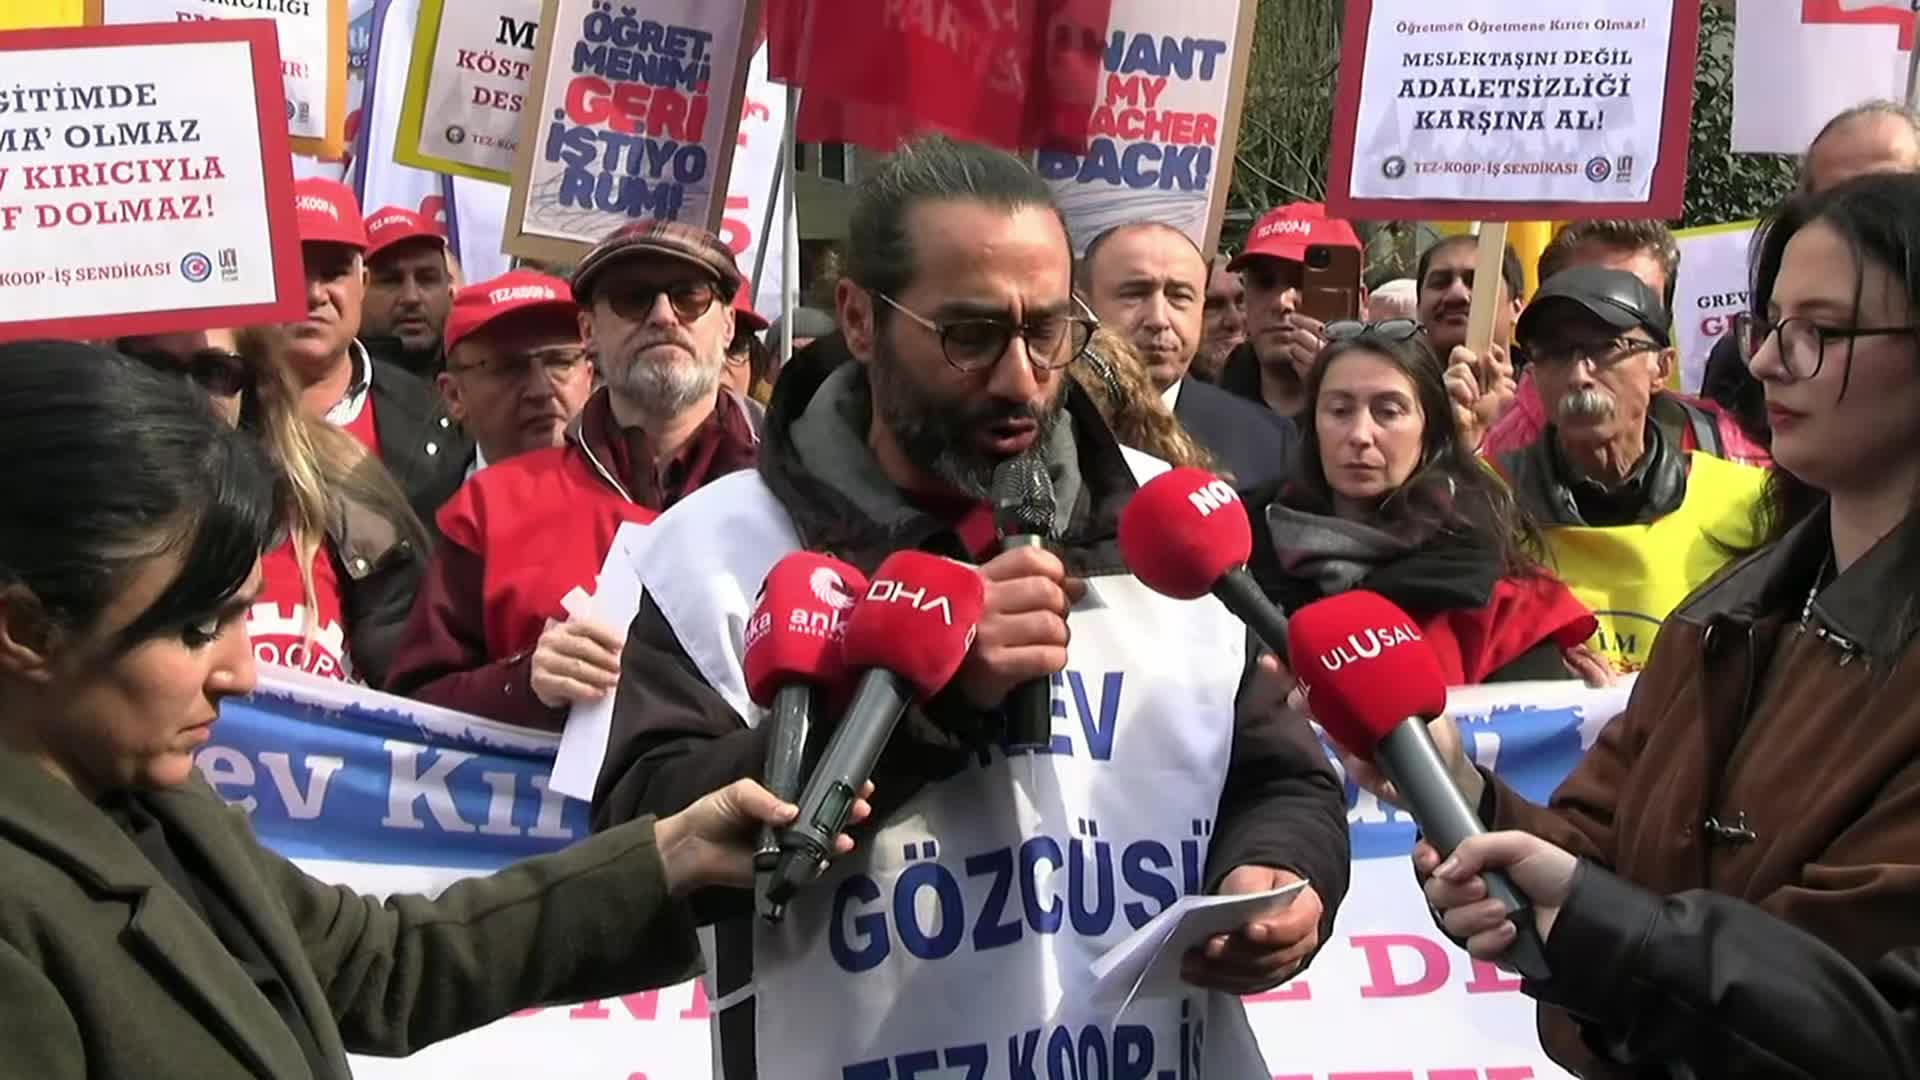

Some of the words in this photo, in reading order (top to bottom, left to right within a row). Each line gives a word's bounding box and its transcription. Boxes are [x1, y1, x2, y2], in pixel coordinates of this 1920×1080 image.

[1396, 20, 1463, 35] Öğretmen
[1467, 19, 1546, 34] Öğretmene
[1550, 19, 1590, 32] Kırıcı
[1594, 17, 1647, 31] Olmaz!
[456, 49, 530, 81] KÖST
[1402, 50, 1557, 70] MESLEKTAŞINI
[1563, 47, 1633, 66] DEĞİL
[472, 86, 523, 113] DES
[1107, 72, 1168, 108] MY
[1397, 72, 1632, 99] ADALETSİZLİĞİ
[565, 75, 709, 144] GERİ
[1087, 104, 1218, 146] ACHER
[1413, 110, 1546, 136] KARŞINA
[1554, 109, 1604, 132] AL!
[64, 119, 201, 148] OLMAZ
[545, 108, 708, 184] İSTİYO
[23, 156, 225, 190] KIRICIYLA
[1502, 159, 1579, 176] SENDİKASI
[559, 164, 684, 221] RUM!
[34, 194, 215, 228] DOLMAZ!
[76, 261, 172, 281] SENDİKASI
[1696, 291, 1749, 309] GREV
[866, 580, 952, 625] DHA
[1320, 623, 1422, 672] ULUSAL
